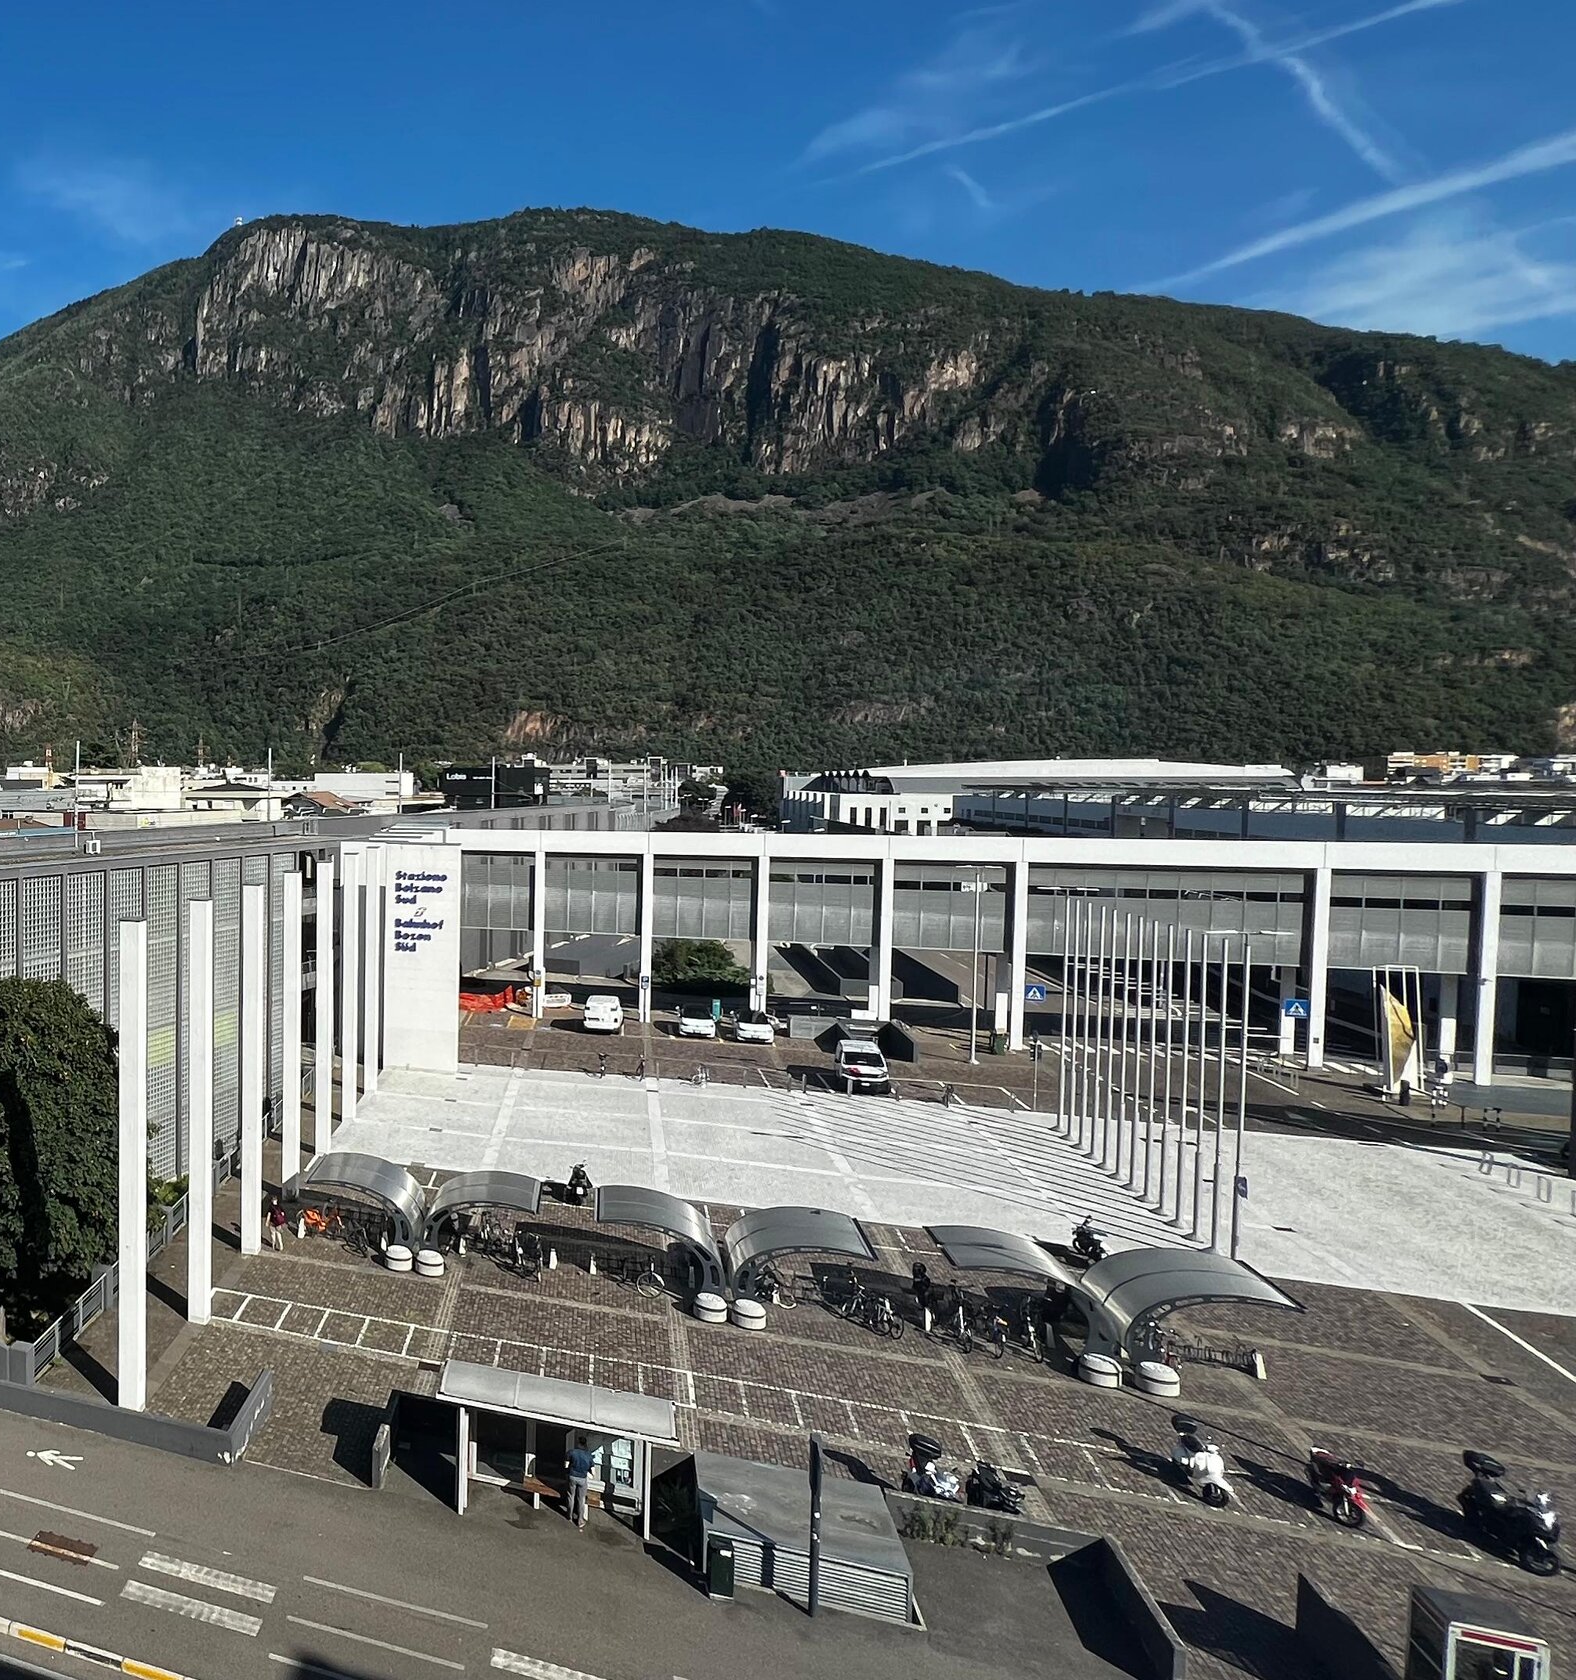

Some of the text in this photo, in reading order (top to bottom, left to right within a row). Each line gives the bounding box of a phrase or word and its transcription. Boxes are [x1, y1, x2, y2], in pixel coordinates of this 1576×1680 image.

[395, 871, 447, 881] Stazione
[395, 883, 443, 893] Bolzano
[395, 895, 417, 904] Sud
[394, 918, 444, 930] Bahnhof
[394, 930, 431, 941] Bozen
[394, 942, 417, 952] Süd
